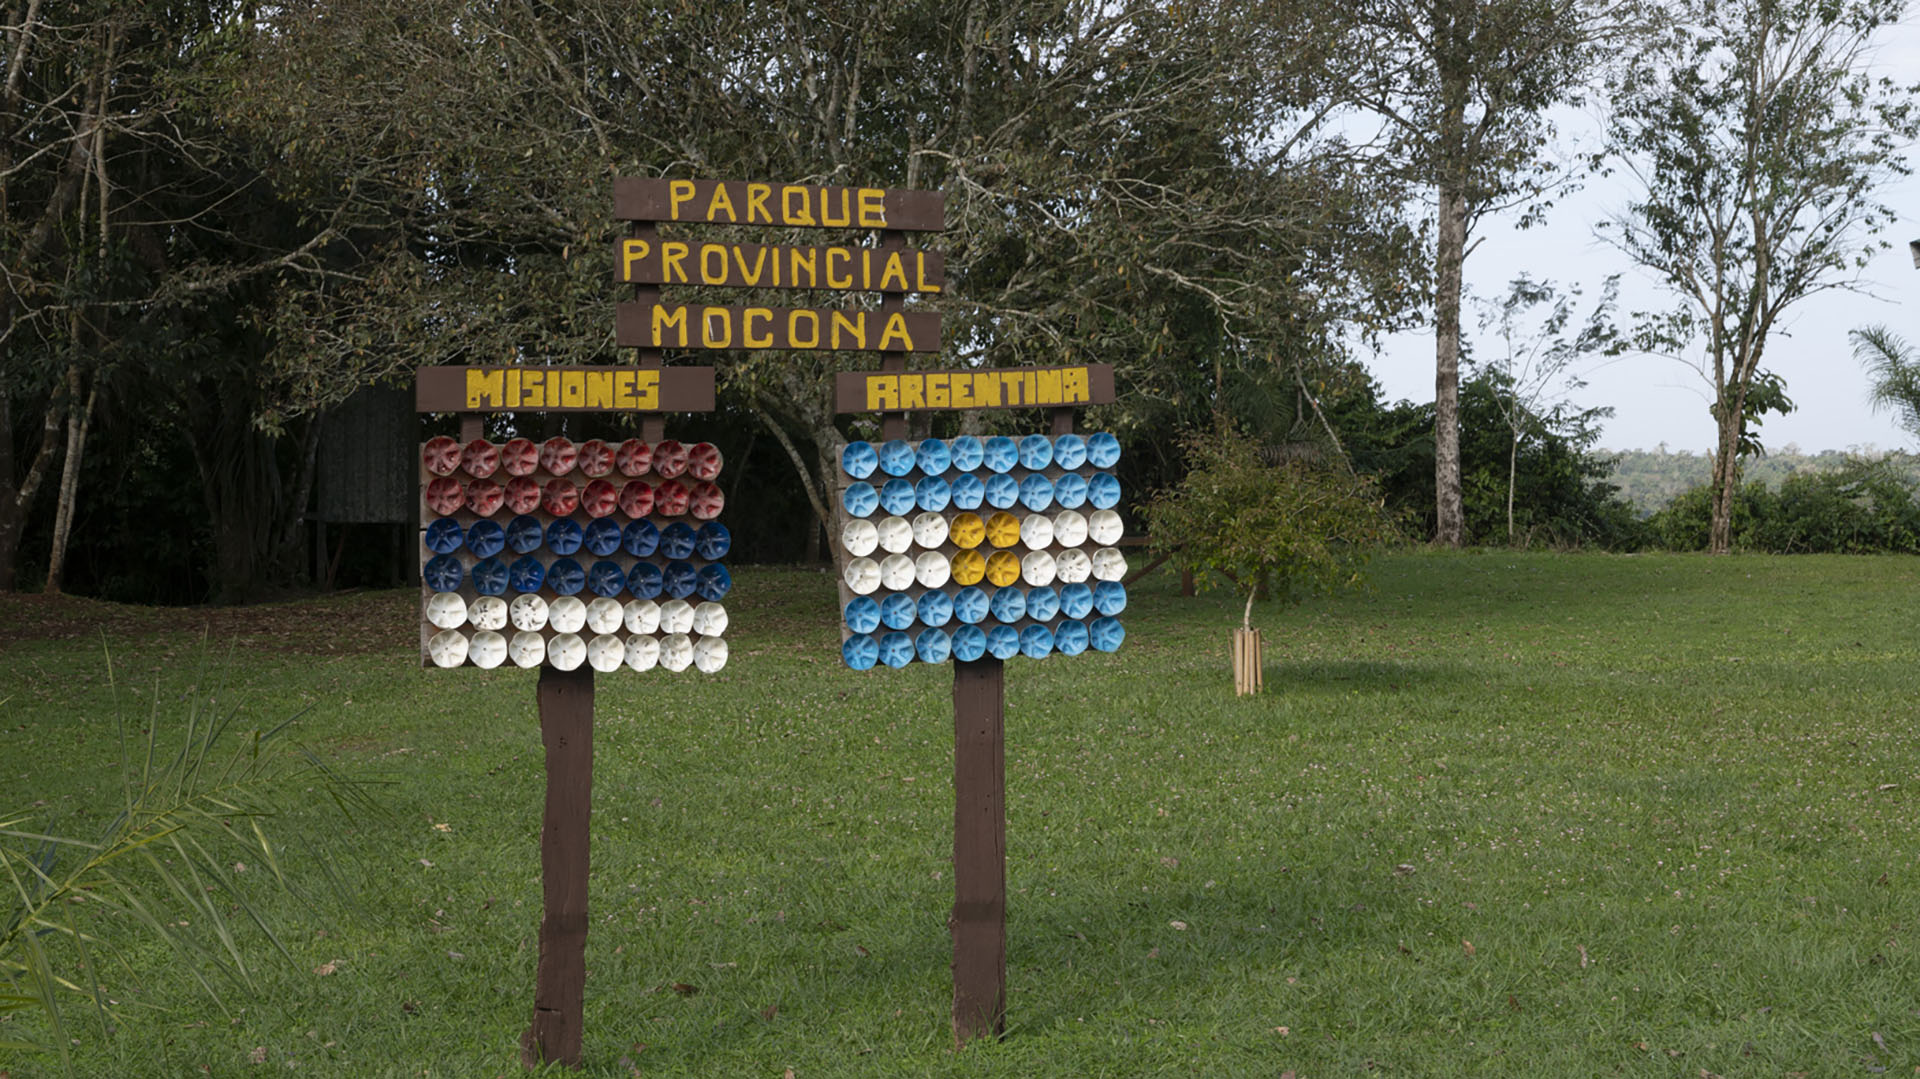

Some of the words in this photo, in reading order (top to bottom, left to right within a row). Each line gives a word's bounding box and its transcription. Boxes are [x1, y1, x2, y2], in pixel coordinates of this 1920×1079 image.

[669, 180, 888, 228] PARQUE
[623, 239, 941, 293] PROVINCIAL
[652, 304, 914, 351] MOCONA
[466, 369, 661, 411] MISIONES
[866, 366, 1091, 411] ARGENTINA
